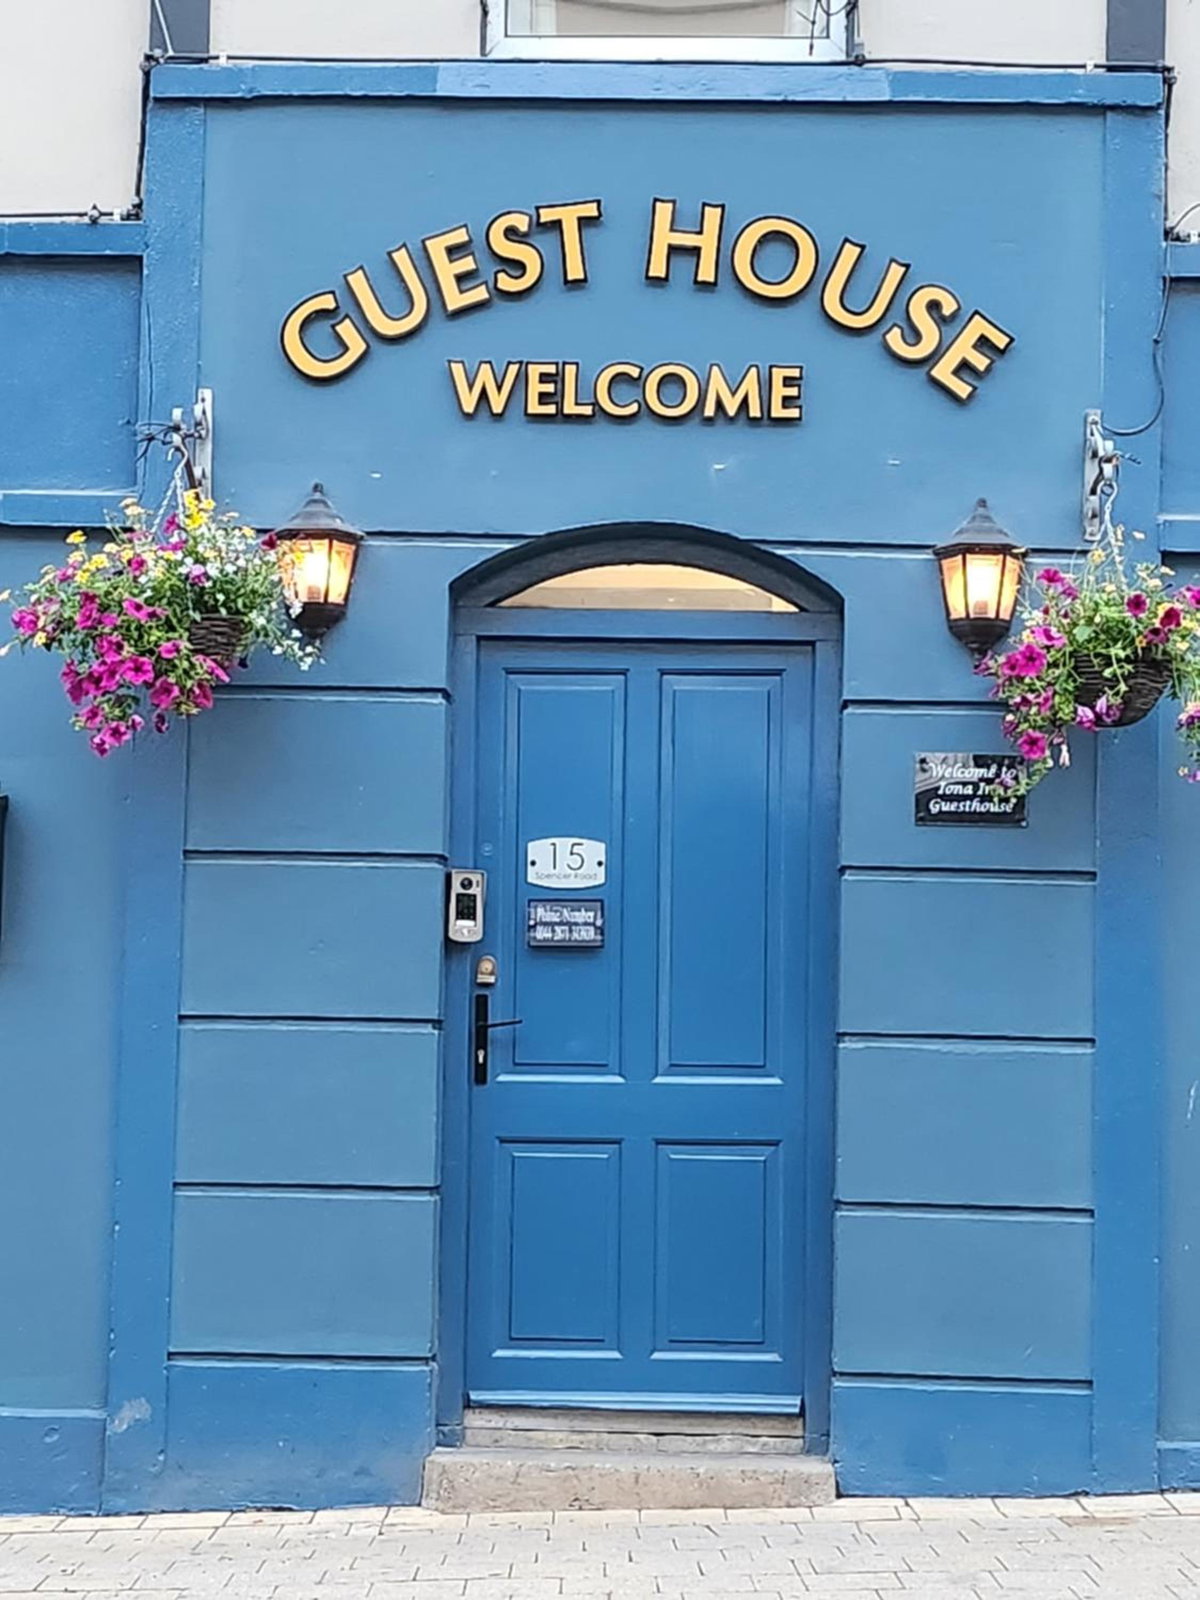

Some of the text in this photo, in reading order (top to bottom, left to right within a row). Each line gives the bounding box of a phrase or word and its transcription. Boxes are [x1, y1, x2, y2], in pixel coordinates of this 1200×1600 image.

[280, 197, 1015, 404] GUEST HOUSE
[448, 359, 803, 420] WELCOME
[928, 762, 1017, 779] Welcome to
[929, 798, 1015, 814] Guesthouse
[550, 842, 585, 871] 15
[535, 872, 598, 881] Spencer Road
